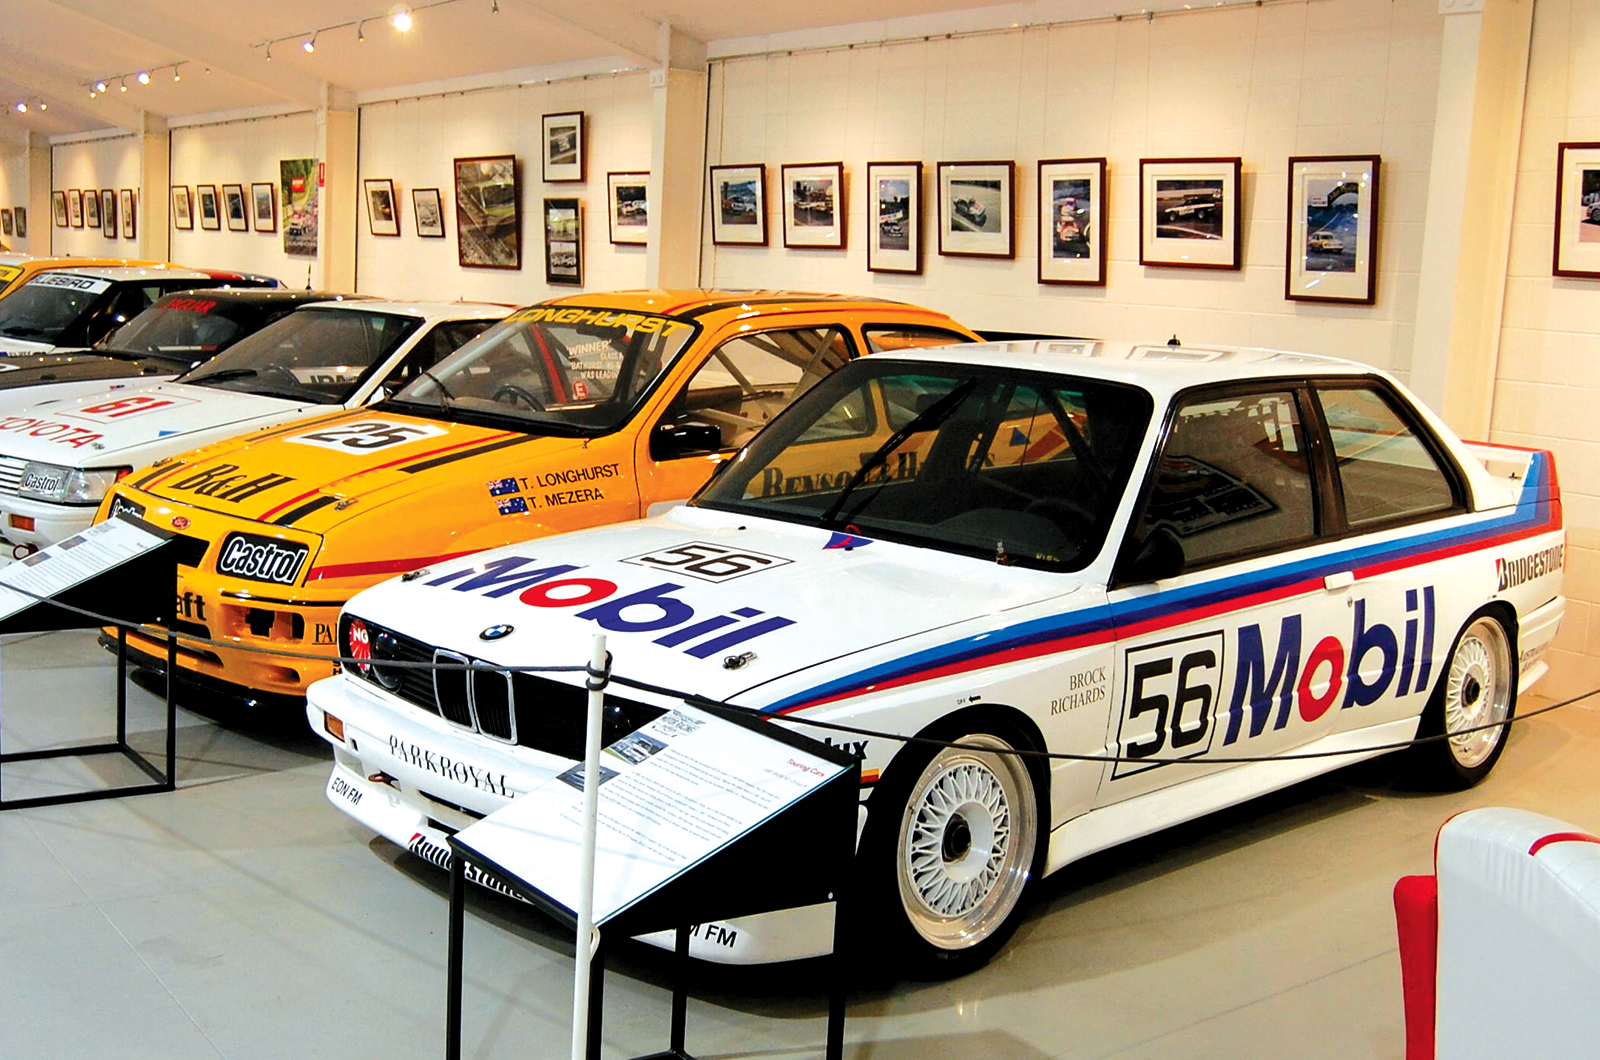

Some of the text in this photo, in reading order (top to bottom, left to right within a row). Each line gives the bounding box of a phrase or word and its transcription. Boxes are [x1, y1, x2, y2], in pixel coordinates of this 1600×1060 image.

[504, 308, 692, 337] LONGHURST
[575, 382, 586, 397] E
[80, 397, 175, 418] 61
[300, 422, 430, 449] 25
[25, 472, 60, 492] Castrol
[519, 463, 619, 489] T. LONGHURST
[528, 488, 604, 509] T. MEZERA
[221, 536, 308, 585] Castrol
[640, 545, 772, 577] 56
[1497, 544, 1564, 592] BRIDGESTONE
[423, 556, 797, 659] Mobil
[1069, 666, 1106, 690] BROCK
[1223, 585, 1435, 746] Mobil
[1051, 686, 1106, 716] RICHARDS
[1126, 649, 1216, 759] 56
[389, 735, 515, 799] PARKROYAL
[331, 777, 363, 805] EON FM
[705, 924, 737, 948] FM
